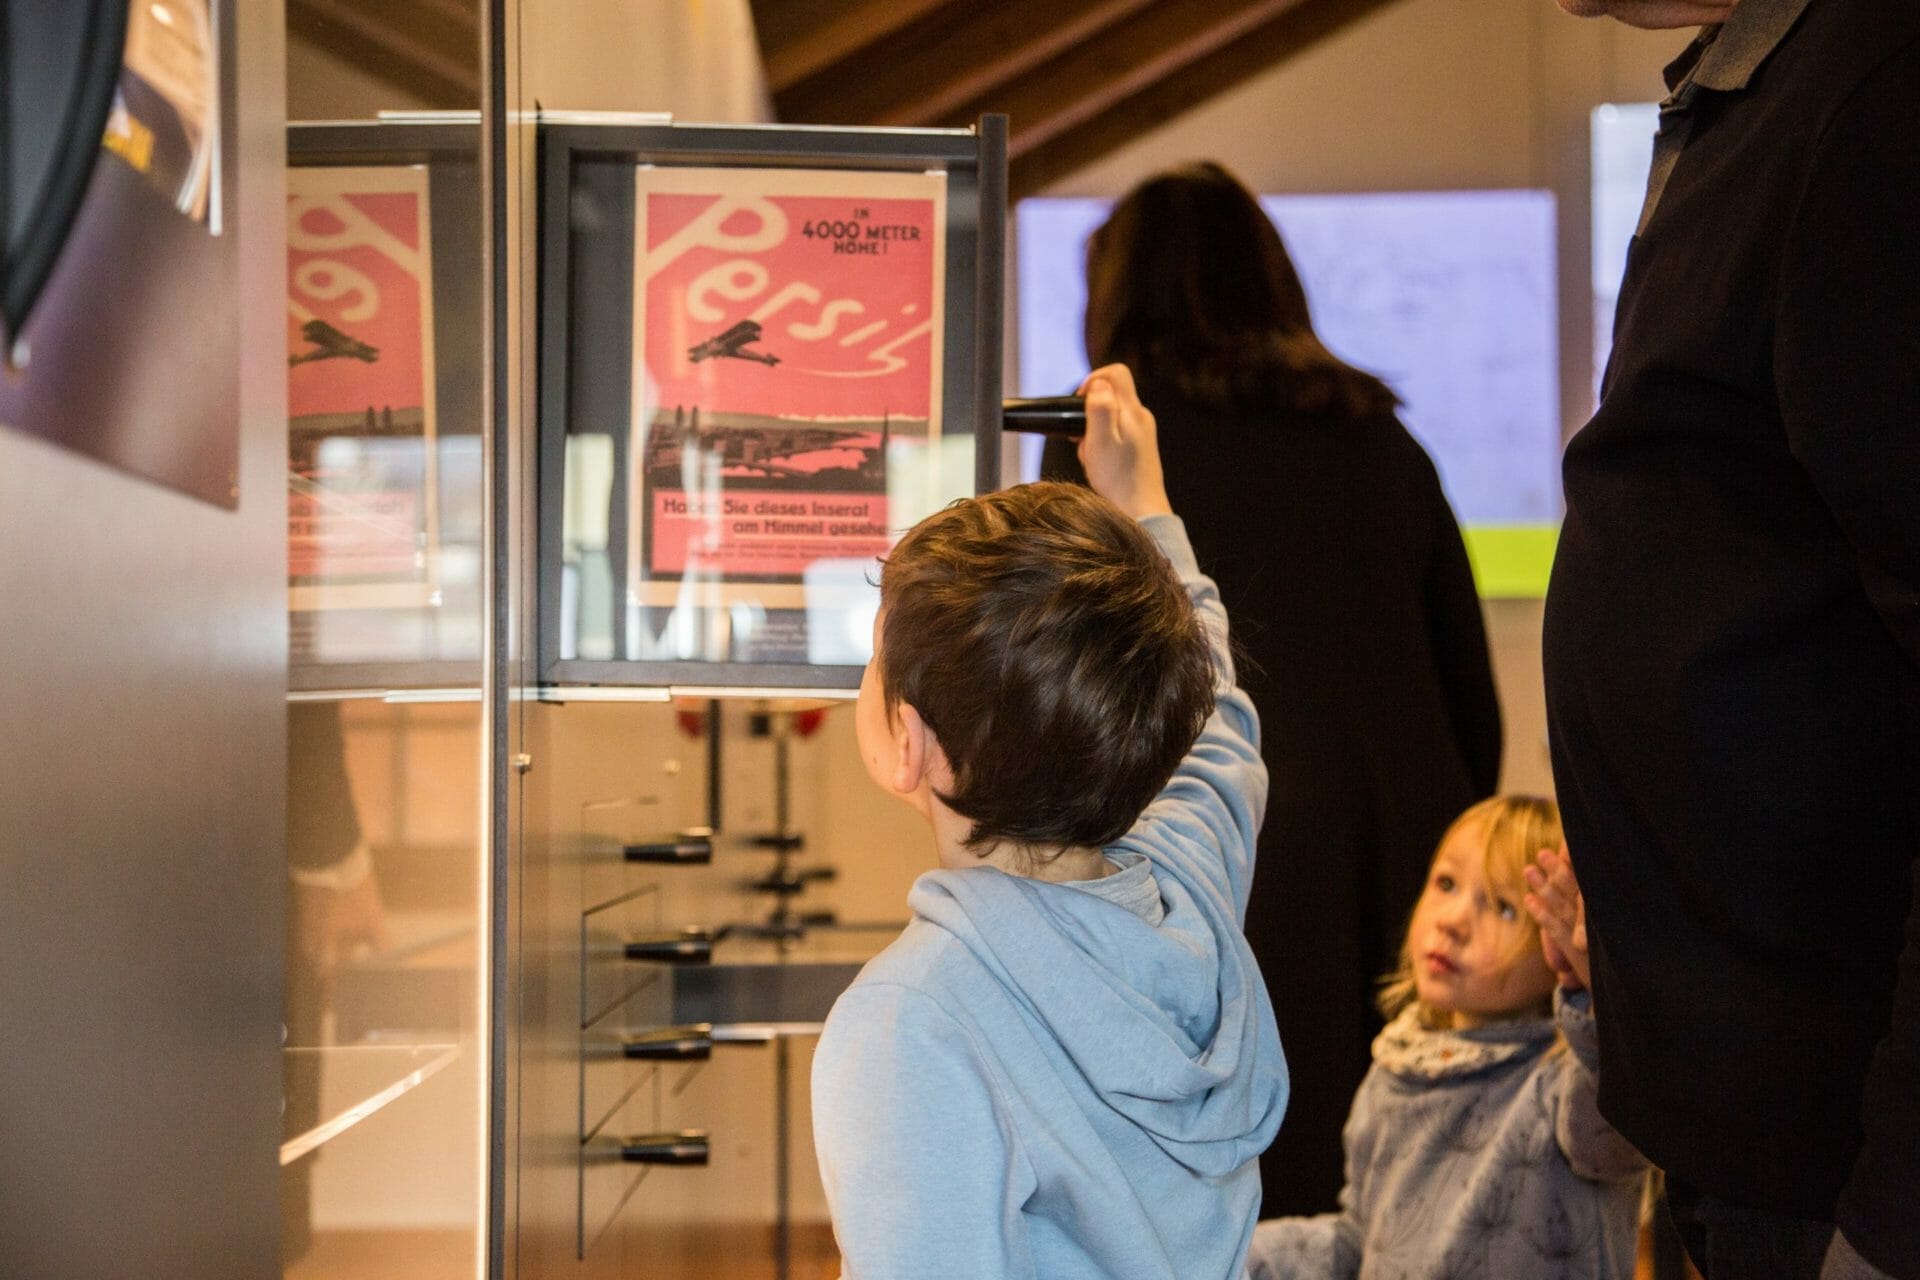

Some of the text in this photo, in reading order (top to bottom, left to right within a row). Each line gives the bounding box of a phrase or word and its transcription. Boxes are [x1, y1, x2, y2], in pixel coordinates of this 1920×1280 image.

[802, 220, 920, 241] 4000 METER
[723, 500, 748, 514] Sie
[753, 501, 806, 515] dieses
[811, 501, 868, 517] Inserat
[732, 520, 889, 537] am Himmel gesehe
